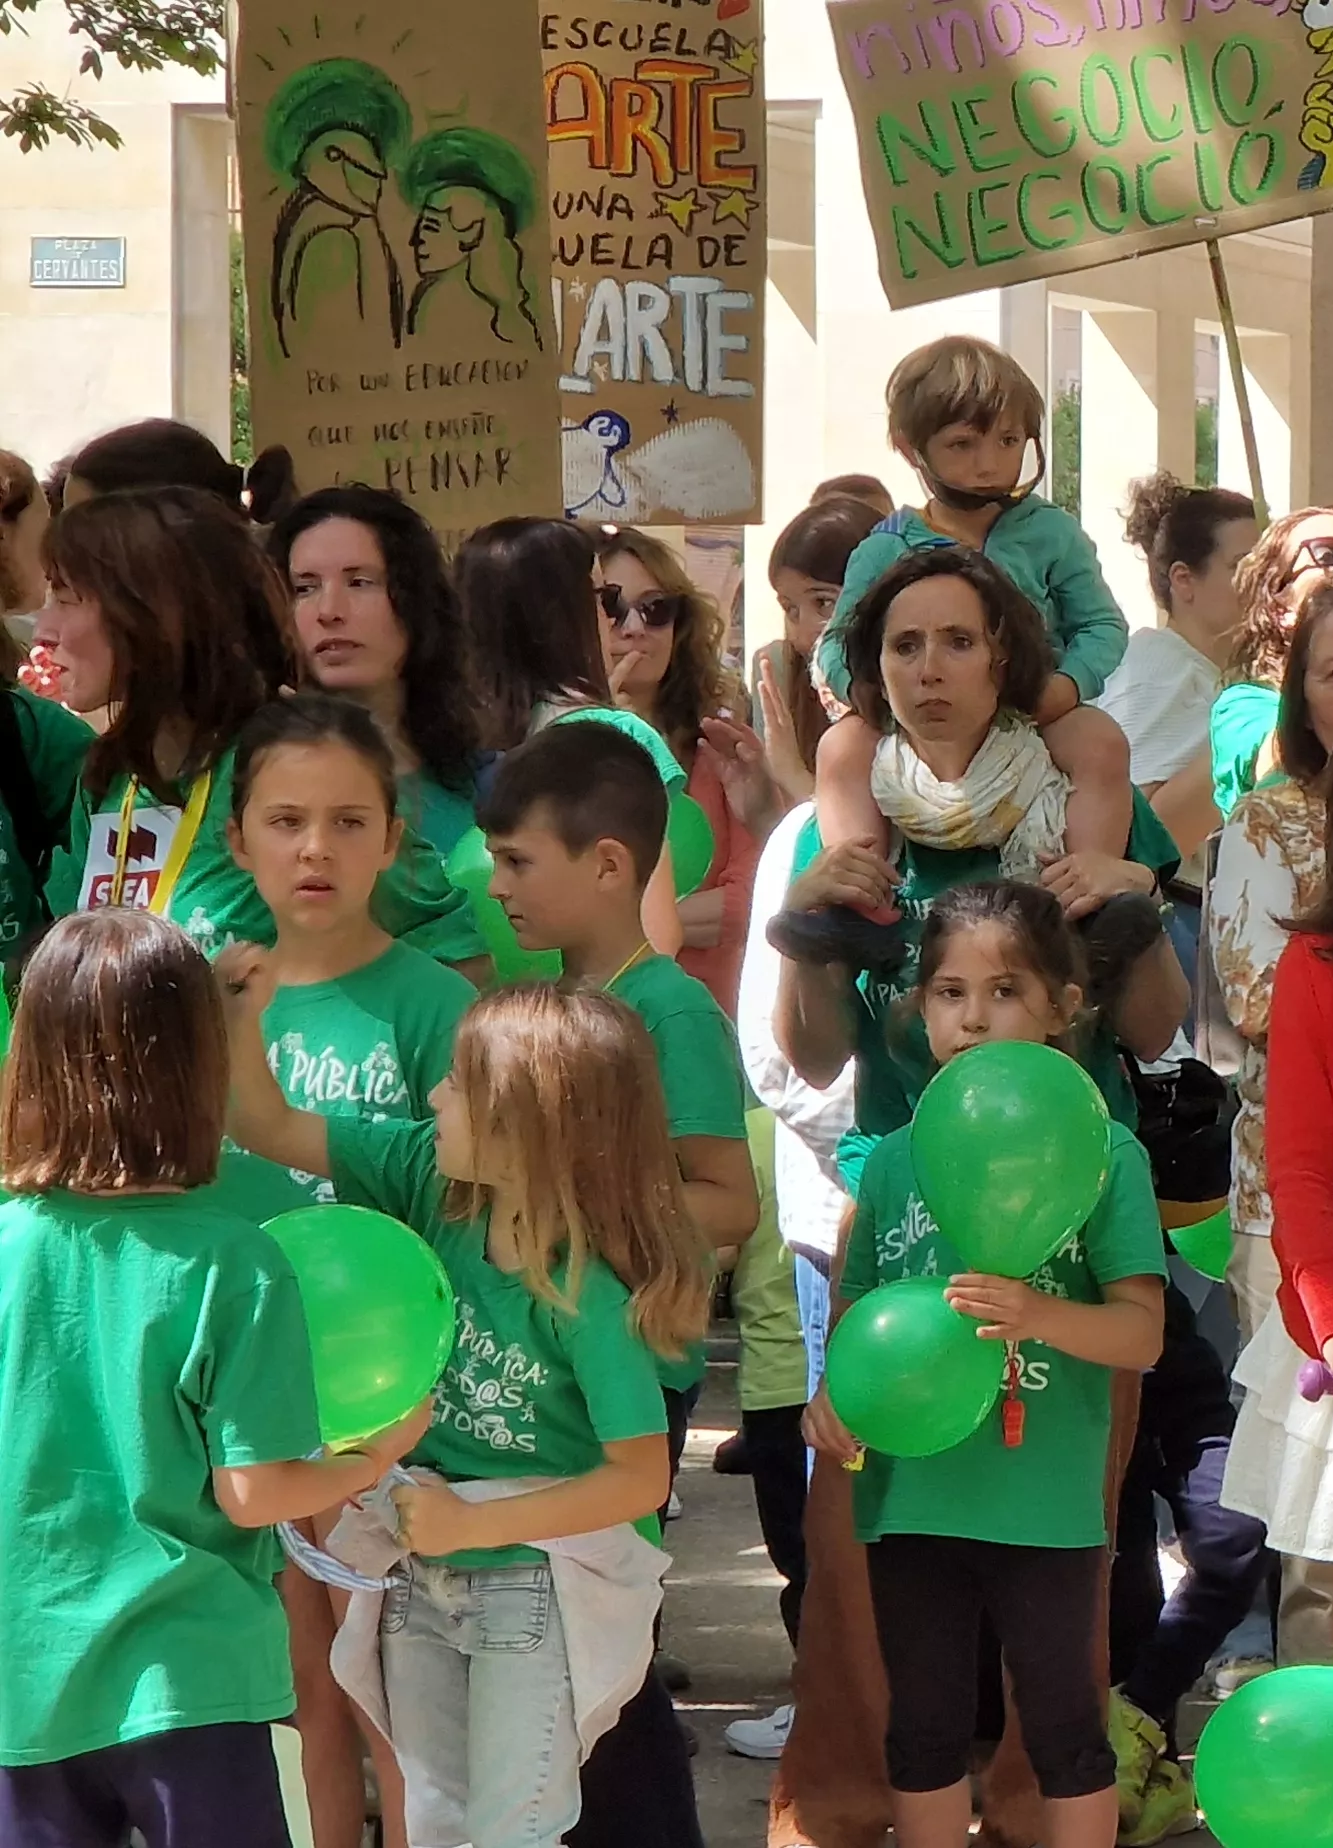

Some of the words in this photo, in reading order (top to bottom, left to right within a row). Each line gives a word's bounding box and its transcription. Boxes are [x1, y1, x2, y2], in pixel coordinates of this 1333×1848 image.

[540, 14, 737, 60] ESCUELA
[545, 59, 757, 190] ARTE
[552, 186, 635, 221] UNA
[697, 234, 748, 268] DE
[33, 259, 119, 280] CERVANTES
[306, 369, 342, 396] POR
[307, 424, 354, 448] QUE
[373, 417, 410, 443] NOS
[384, 446, 521, 494] PENSAR
[95, 876, 149, 908] SEA
